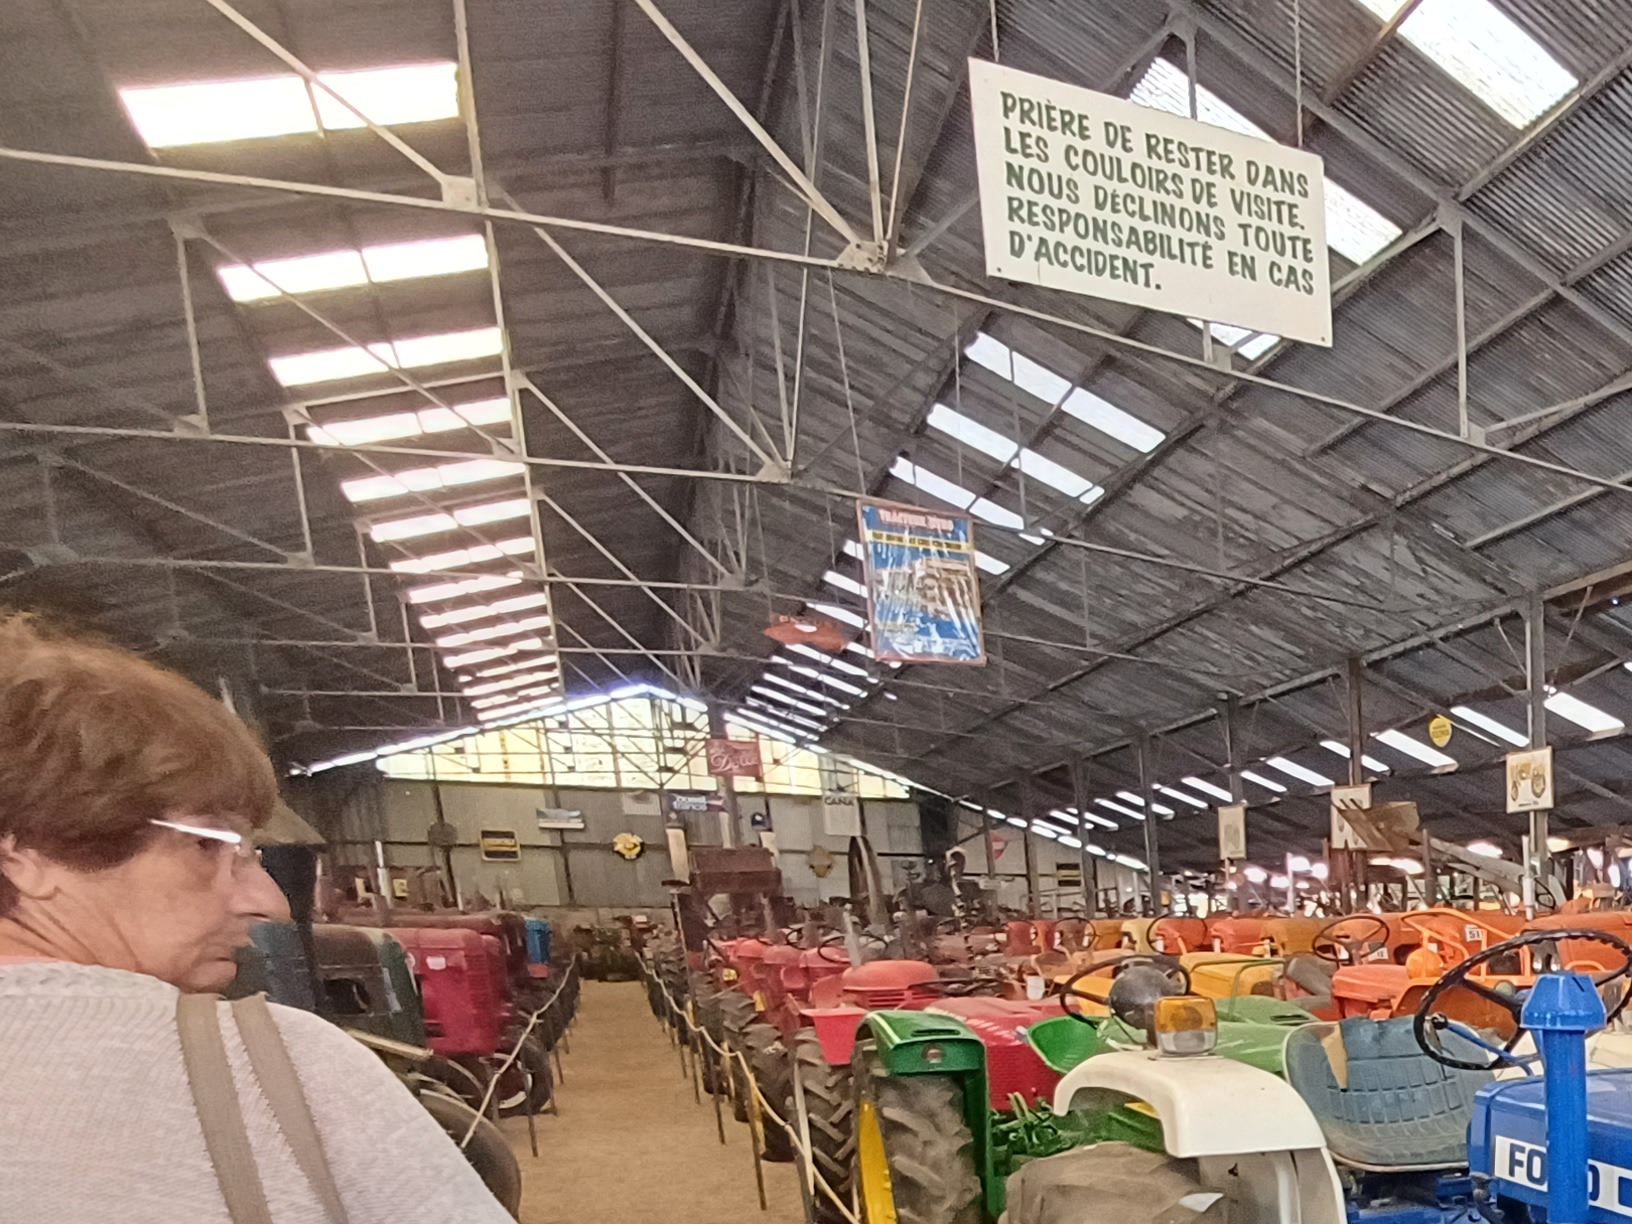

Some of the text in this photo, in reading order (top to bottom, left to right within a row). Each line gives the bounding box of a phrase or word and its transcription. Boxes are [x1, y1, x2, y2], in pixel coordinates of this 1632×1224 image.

[1000, 91, 1309, 199] PRIÈRE DE RESTER DANS
[1003, 126, 1306, 231] LES COULOIRS DE VISITE.
[1005, 161, 1314, 264] NOUS DÉCLINONS TOUTE
[1006, 195, 1315, 297] RESPONSABILITÉ EN CAS
[1008, 230, 1163, 291] D'ACCIDENT.
[1508, 1143, 1600, 1202] FOD
